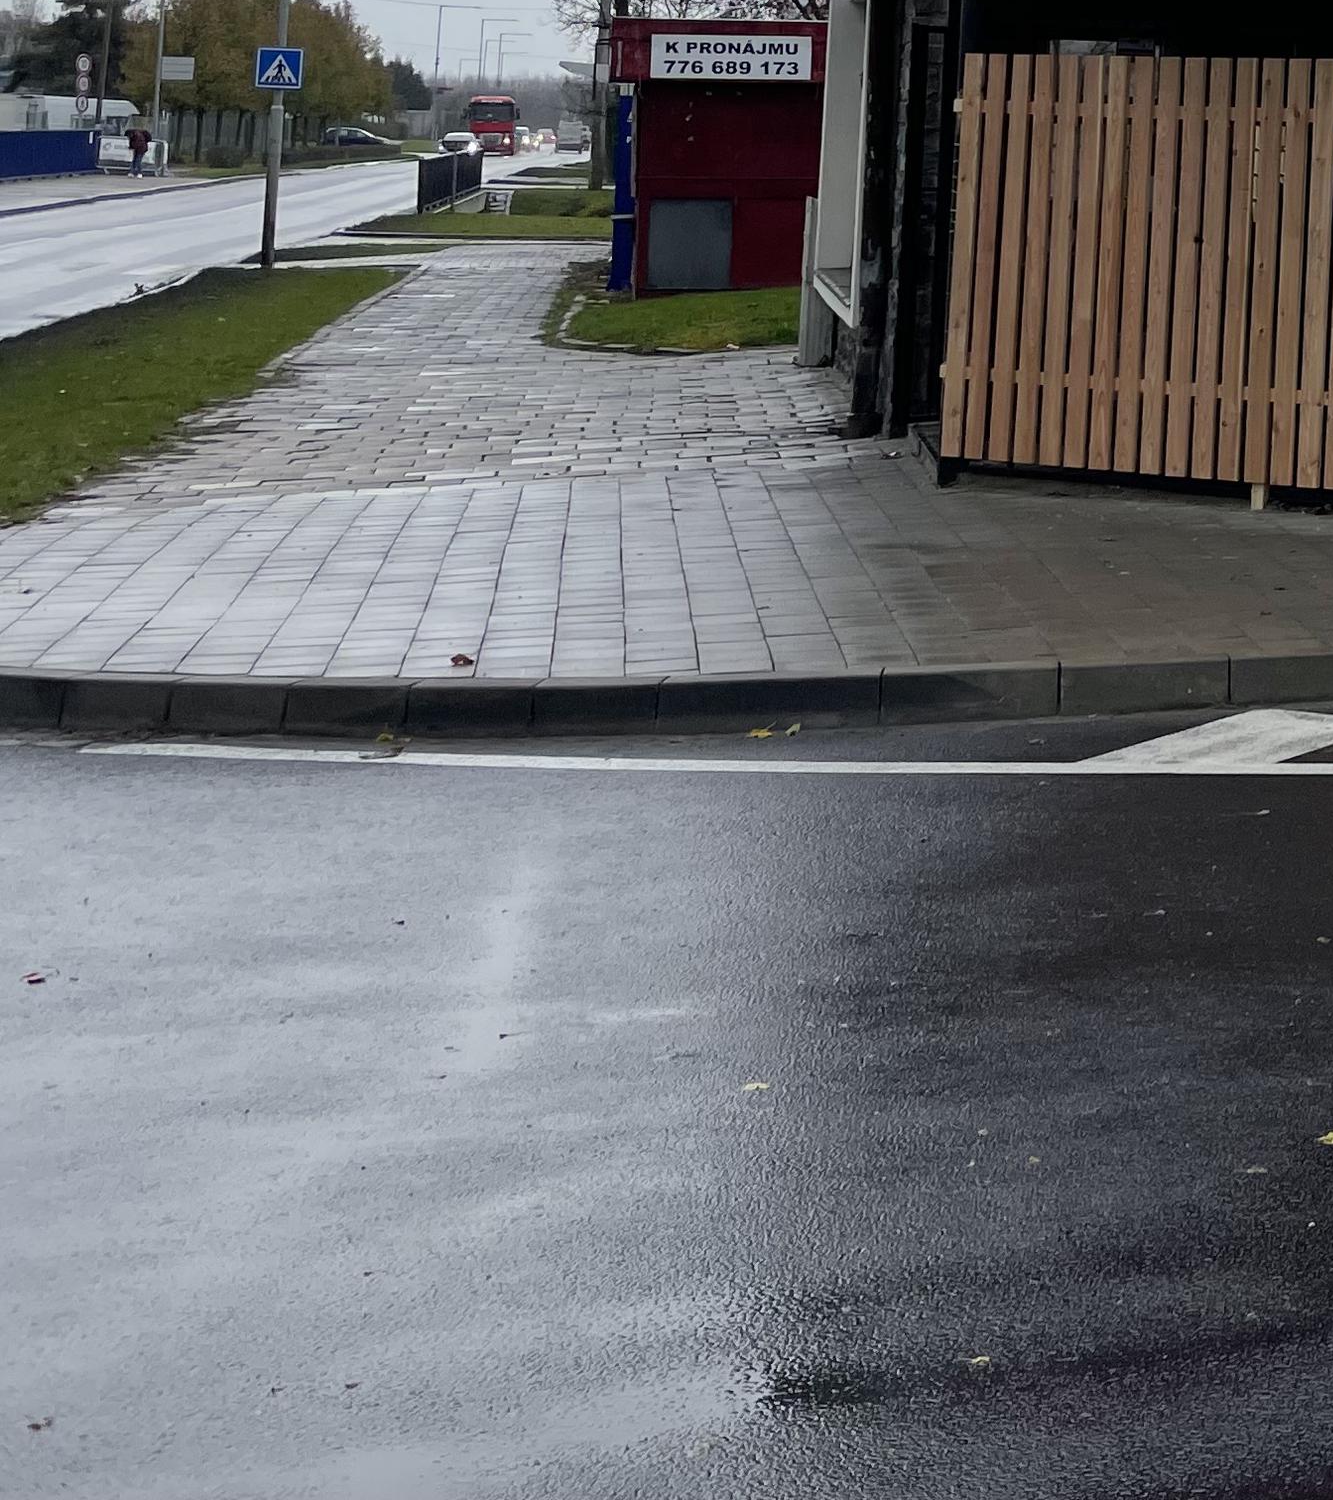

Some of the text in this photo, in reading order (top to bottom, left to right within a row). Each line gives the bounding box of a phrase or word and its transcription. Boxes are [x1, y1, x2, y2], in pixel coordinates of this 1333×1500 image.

[665, 40, 799, 55] K PRONÁJMU
[664, 60, 799, 75] 776 689 173
